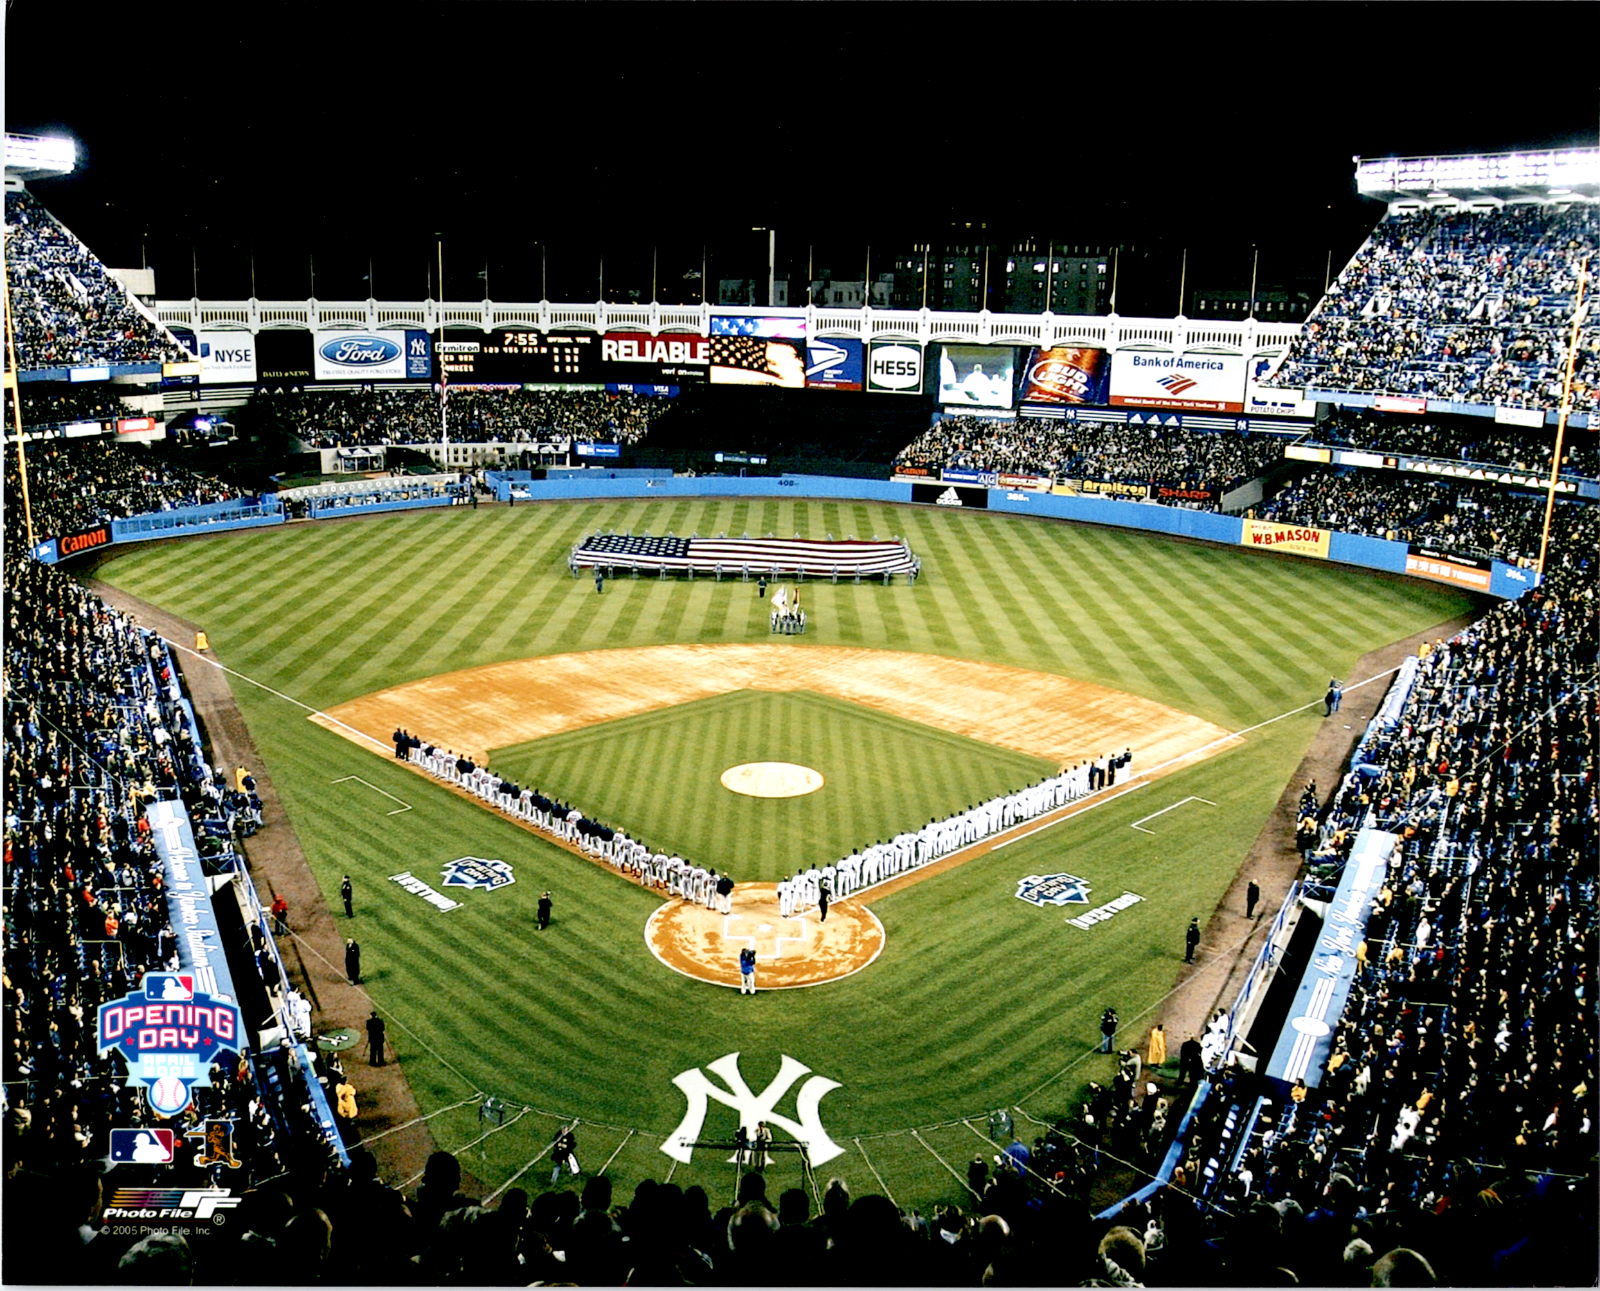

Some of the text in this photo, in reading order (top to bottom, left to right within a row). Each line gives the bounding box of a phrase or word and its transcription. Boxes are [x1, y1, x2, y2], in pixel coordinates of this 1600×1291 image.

[504, 333, 538, 345] 7:55
[215, 349, 251, 362] NYSE
[336, 341, 386, 361] Ford
[602, 339, 710, 365] RELIABLE
[661, 367, 687, 375] verion
[874, 360, 916, 376] HESS
[1133, 356, 1223, 370] Bank of America
[1050, 363, 1089, 383] BUD
[1037, 371, 1090, 394] LIGHT
[895, 466, 928, 475] Canon
[978, 472, 995, 483] AIG
[1083, 480, 1146, 494] Armitron
[1159, 487, 1211, 500] SHARP
[60, 528, 107, 555] Canon
[458, 859, 508, 885] OPENING
[463, 867, 488, 880] DAY
[1023, 876, 1077, 900] OPENING
[1043, 884, 1068, 897] DAY
[167, 890, 209, 925] Yankee
[1313, 888, 1367, 981] New York Yankees
[186, 926, 218, 968] Stadium
[659, 1052, 846, 1168] NY
